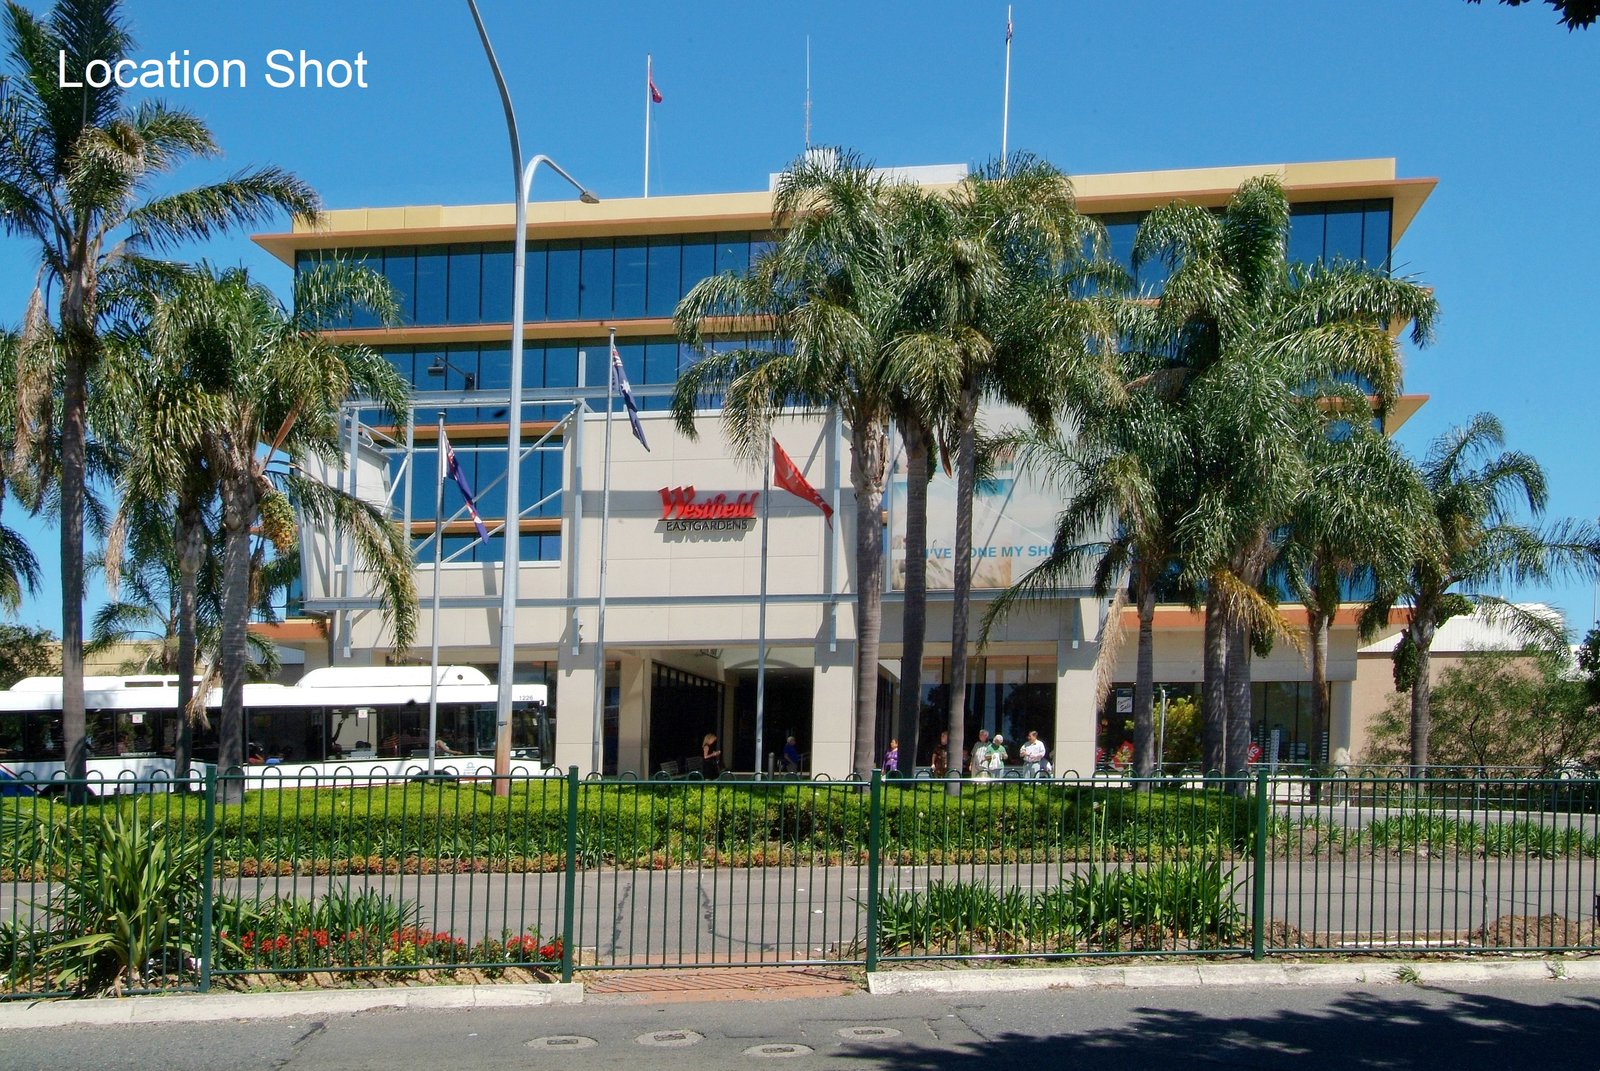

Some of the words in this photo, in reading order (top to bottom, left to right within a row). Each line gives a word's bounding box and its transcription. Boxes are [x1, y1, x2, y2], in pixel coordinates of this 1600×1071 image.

[657, 485, 759, 520] Westfield
[666, 520, 748, 532] EASTGARDENS
[957, 546, 997, 558] ONE
[1001, 546, 1024, 557] MY
